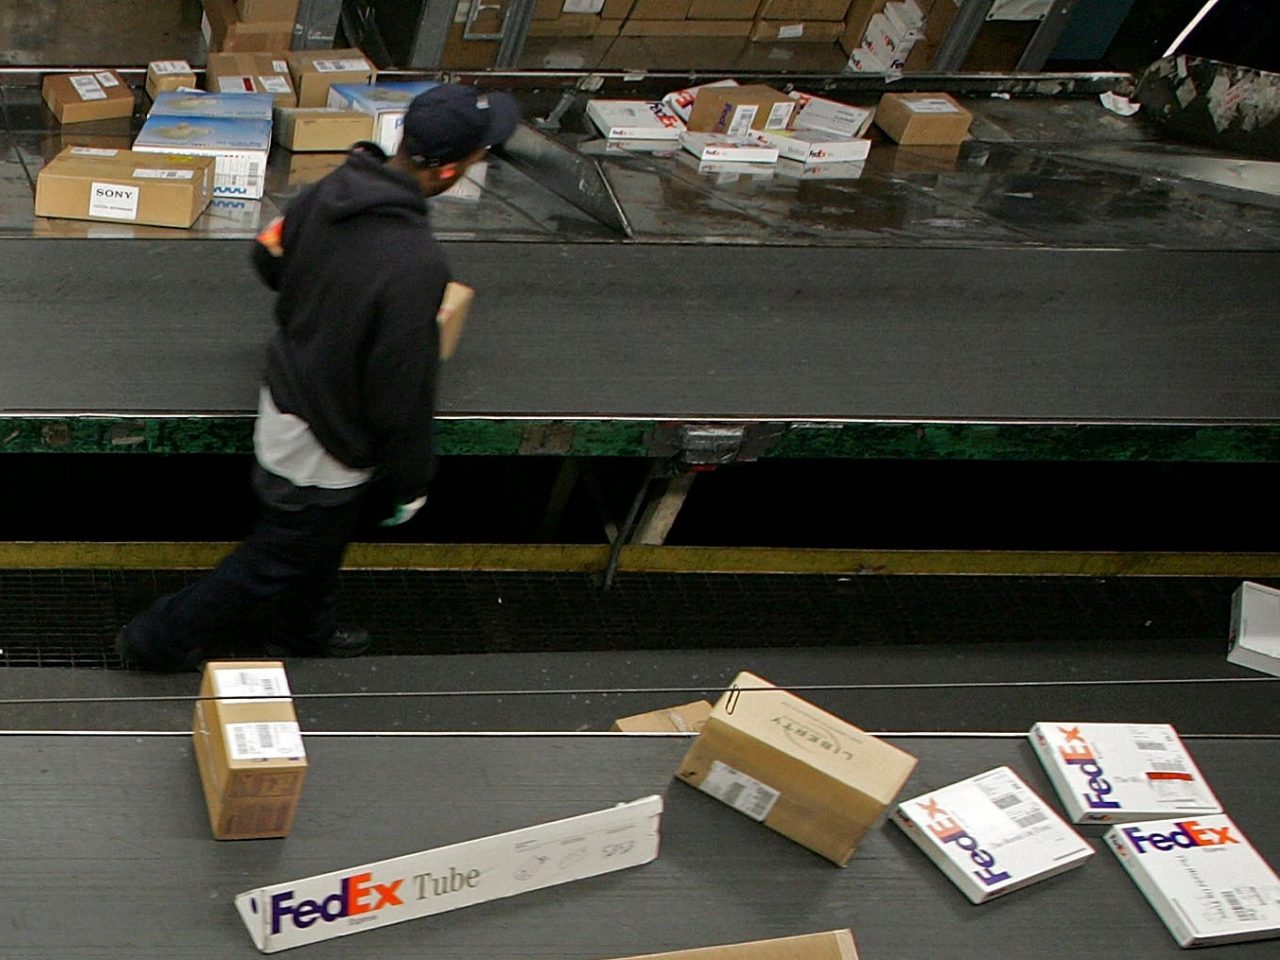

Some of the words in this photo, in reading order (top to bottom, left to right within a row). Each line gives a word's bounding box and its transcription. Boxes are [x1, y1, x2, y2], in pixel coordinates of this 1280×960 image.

[96, 188, 133, 199] SONY
[771, 716, 854, 761] LIBERTY
[1057, 726, 1123, 809] FedEx
[915, 797, 1014, 887] FedEx
[1122, 820, 1242, 854] FedEx
[269, 871, 404, 936] FedEx
[412, 864, 481, 902] Tube
